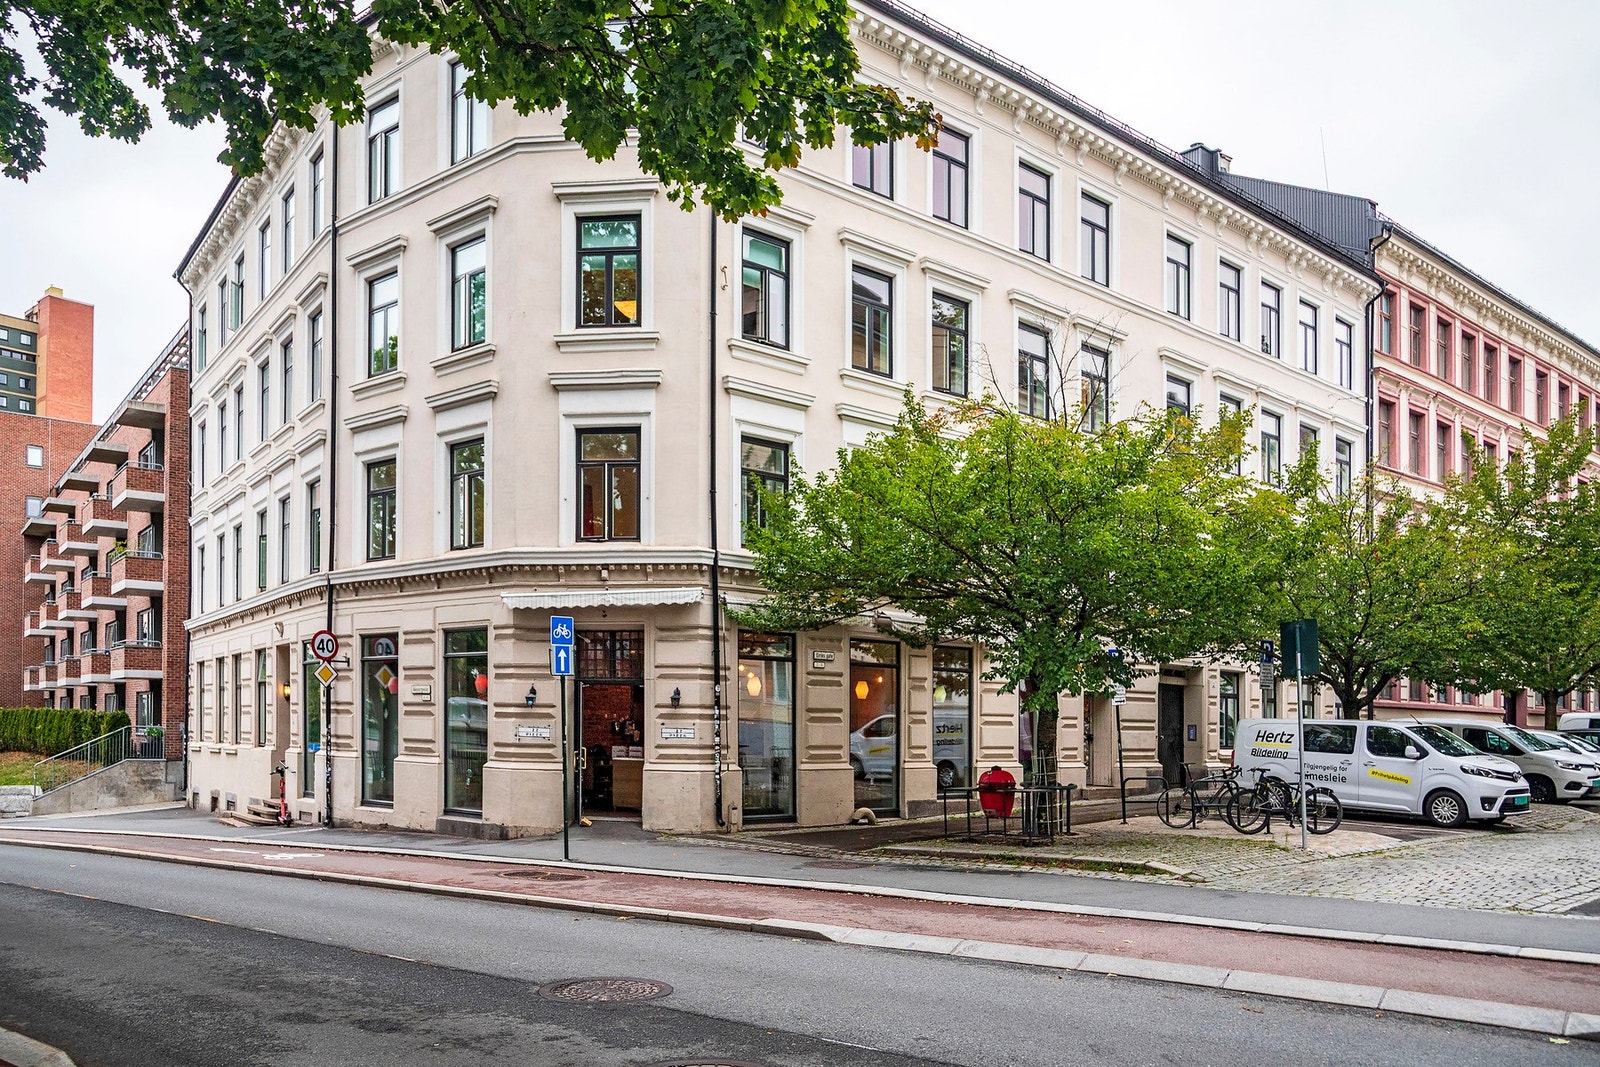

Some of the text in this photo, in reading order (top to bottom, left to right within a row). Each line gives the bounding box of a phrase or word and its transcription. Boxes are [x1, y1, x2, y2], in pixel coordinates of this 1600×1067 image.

[317, 638, 335, 653] 40
[1255, 730, 1295, 744] Hertz
[1251, 748, 1289, 759] Bildeling
